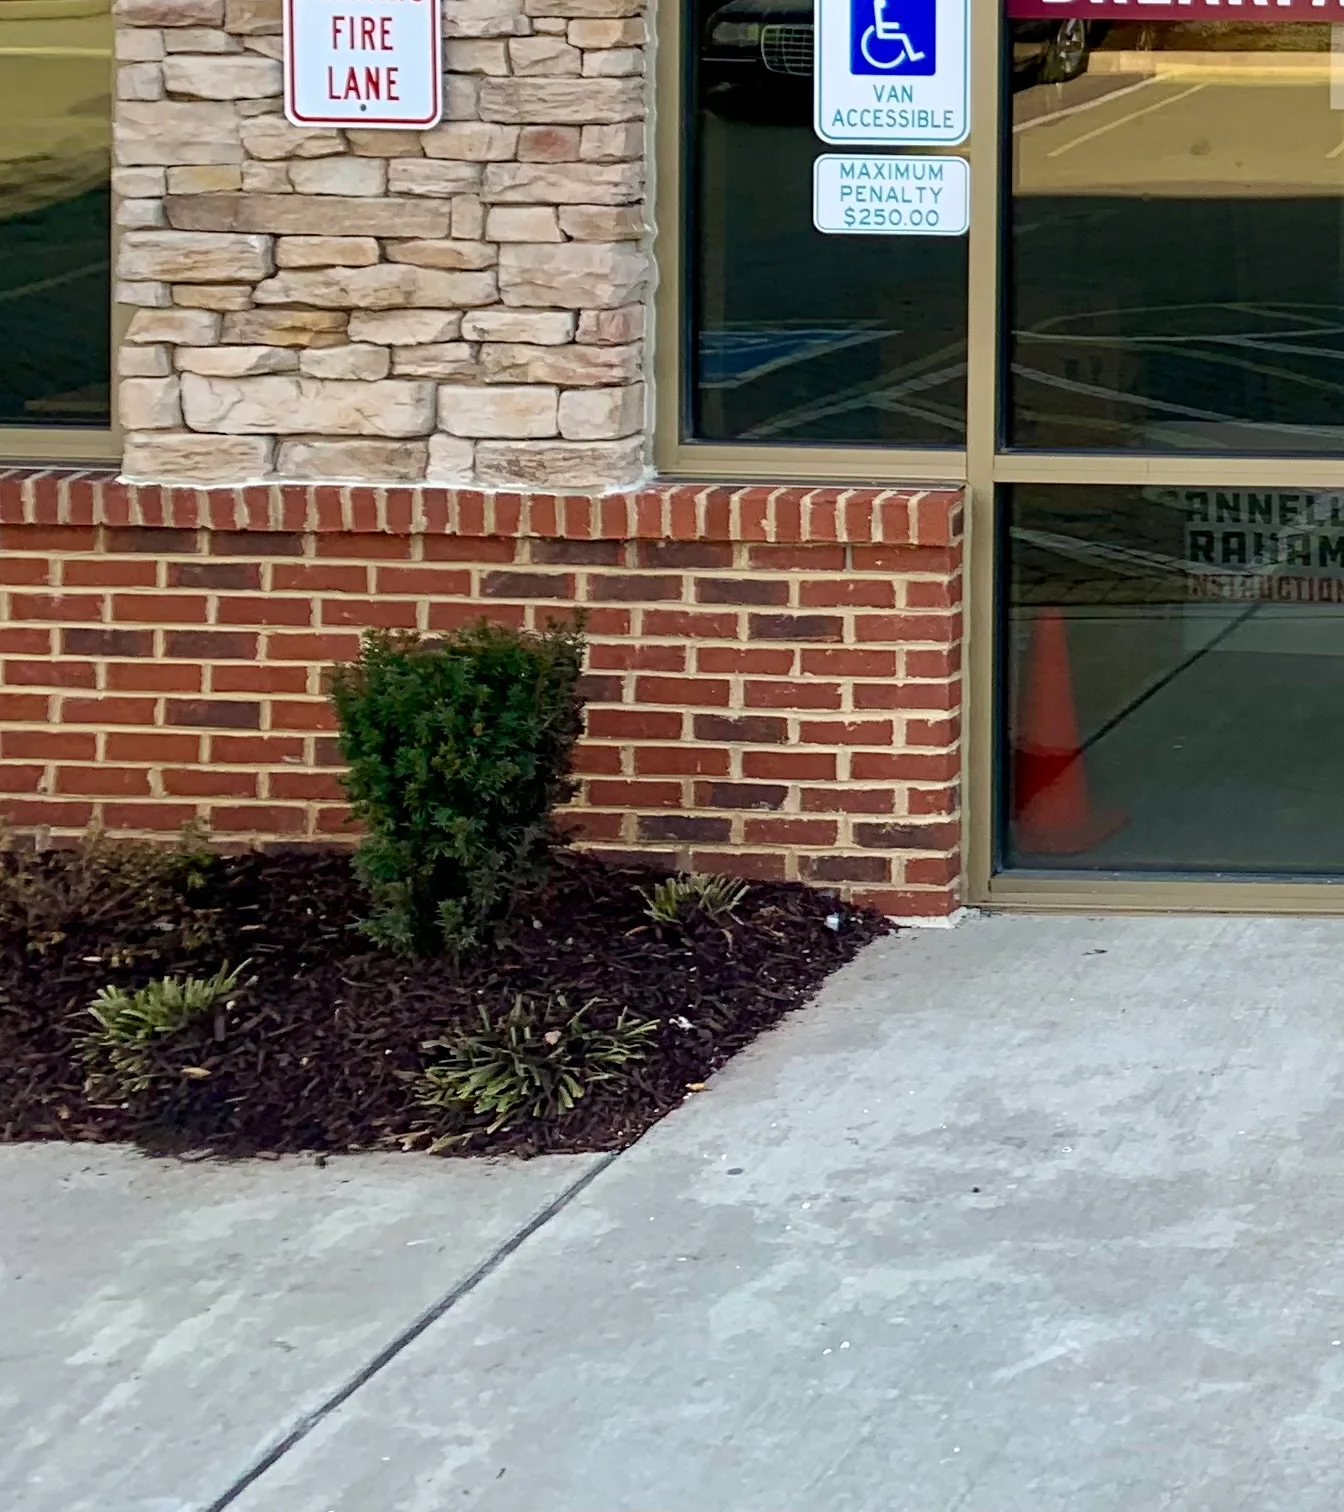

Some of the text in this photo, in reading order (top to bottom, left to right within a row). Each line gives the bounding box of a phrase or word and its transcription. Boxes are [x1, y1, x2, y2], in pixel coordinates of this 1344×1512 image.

[332, 16, 393, 50] FIRE
[328, 66, 399, 101] LANE
[873, 84, 914, 103] VAN
[832, 108, 954, 129] ACCESSIBLE
[840, 162, 944, 181] MAXIMUM
[840, 185, 943, 204] PENALTY
[844, 206, 939, 227] $250.00
